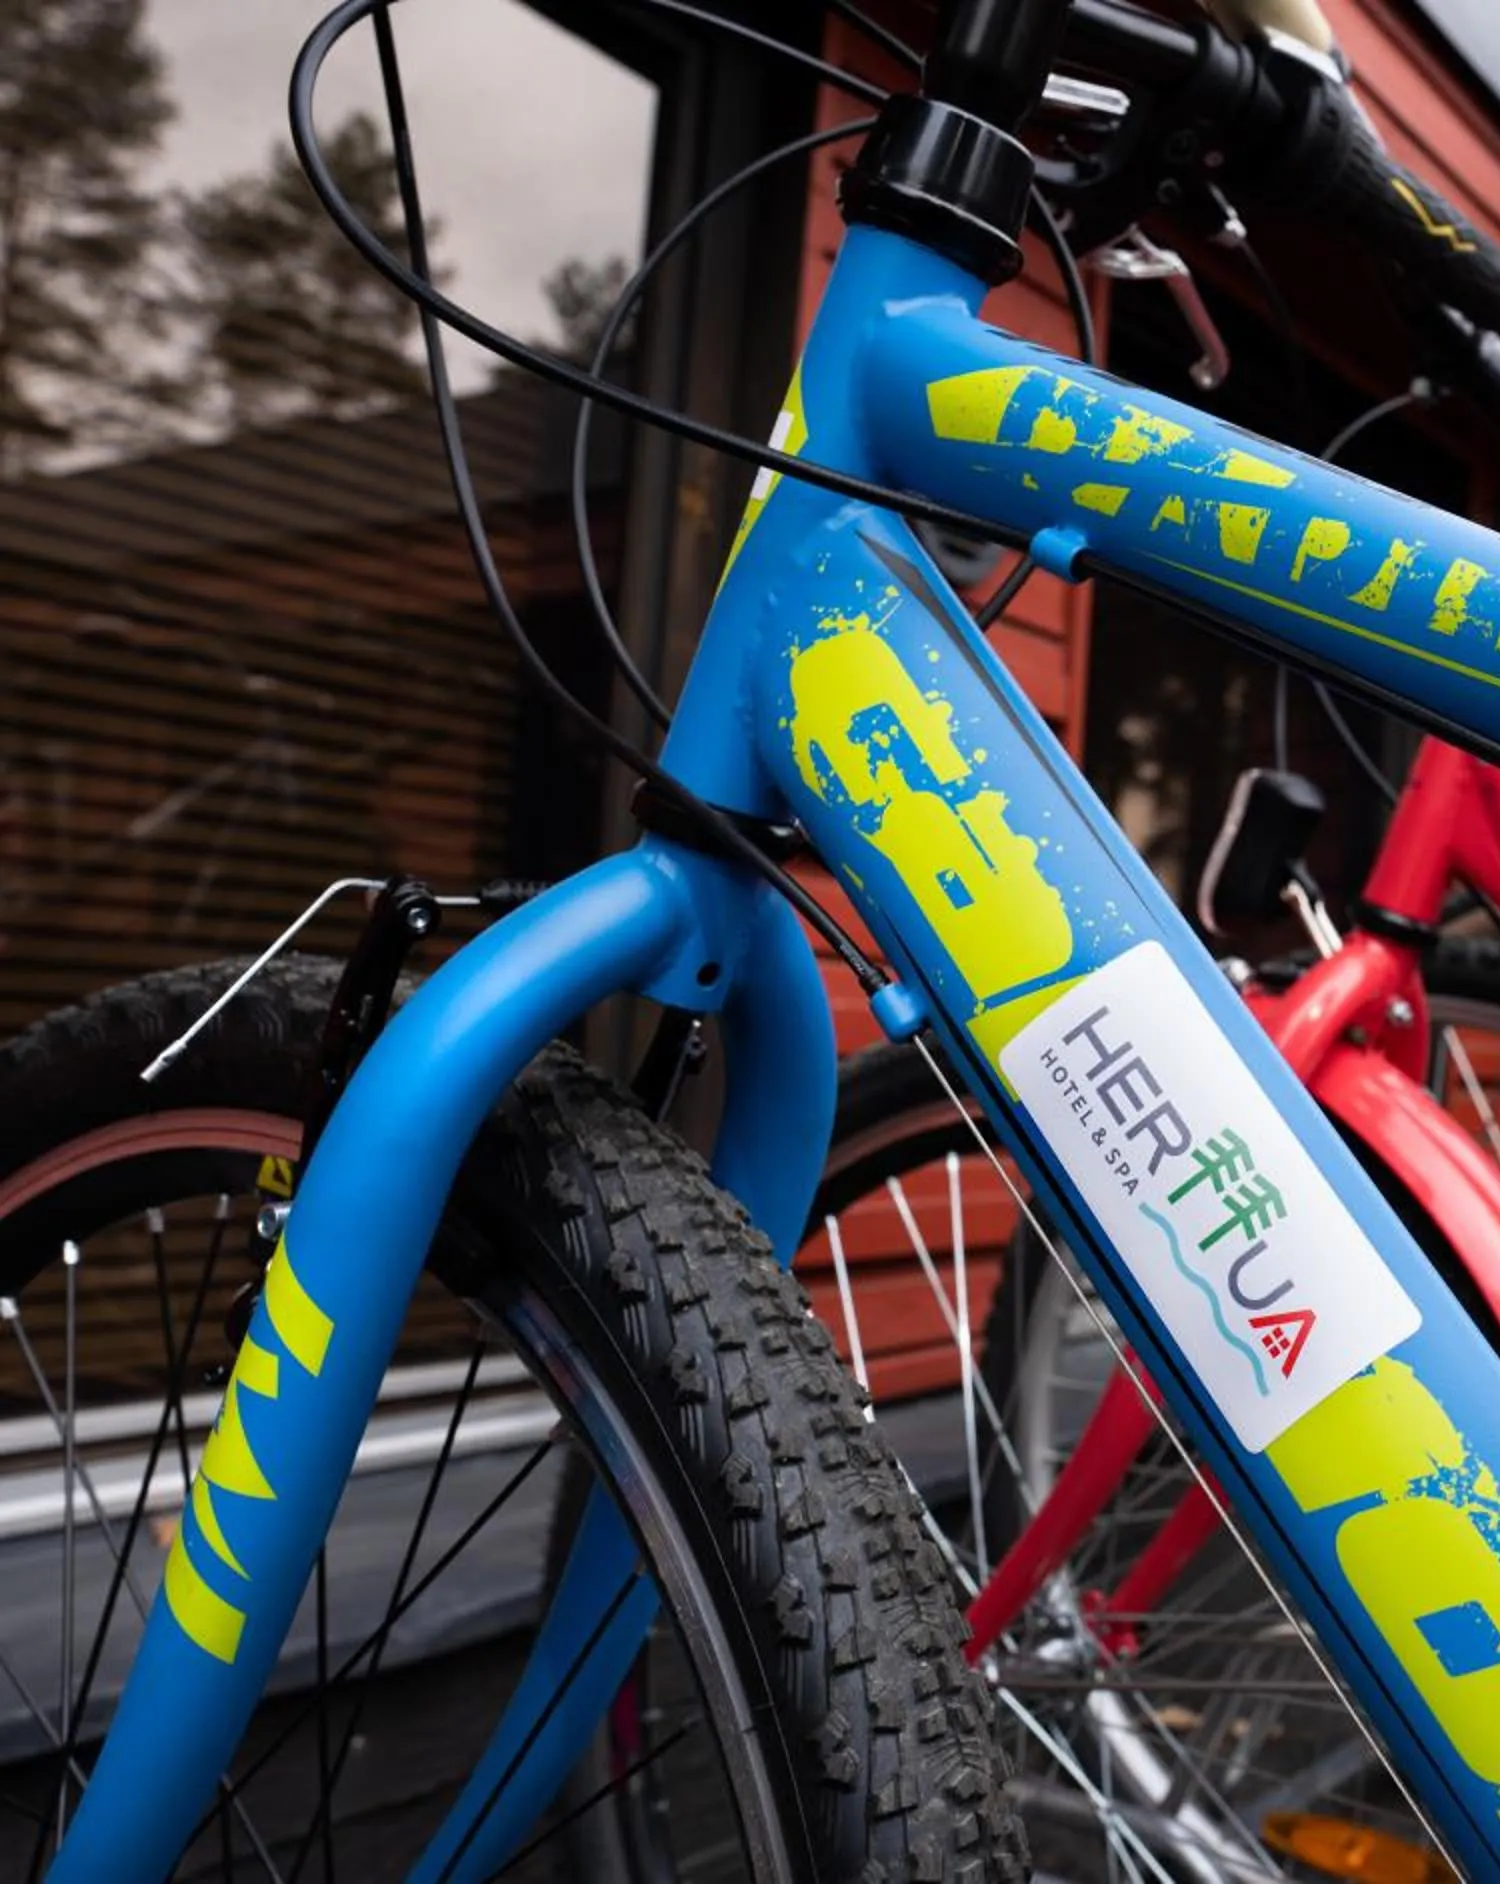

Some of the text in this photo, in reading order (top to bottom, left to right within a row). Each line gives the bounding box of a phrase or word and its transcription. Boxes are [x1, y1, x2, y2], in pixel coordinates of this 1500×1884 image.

[1040, 1048, 1139, 1197] HOTEL & SPA
[1062, 1006, 1317, 1380] HERTTUA
